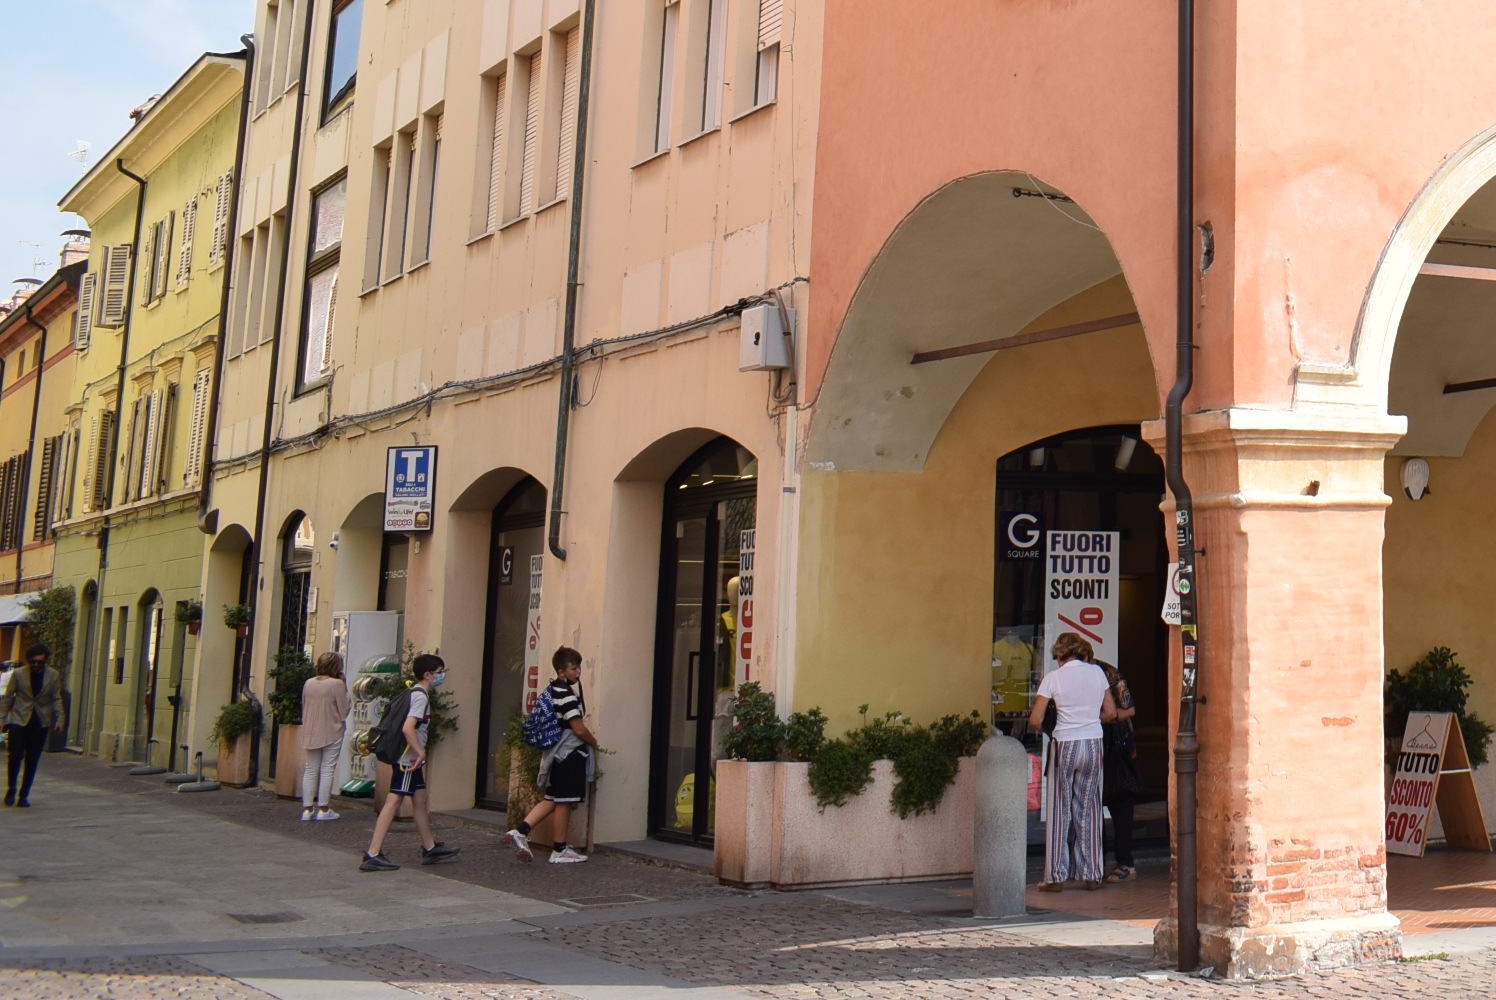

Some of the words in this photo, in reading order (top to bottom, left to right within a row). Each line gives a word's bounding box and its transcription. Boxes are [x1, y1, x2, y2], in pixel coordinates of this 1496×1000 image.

[401, 451, 423, 482] T
[1008, 513, 1040, 548] G
[1050, 533, 1111, 552] FUORI
[502, 548, 511, 575] G
[1007, 550, 1039, 558] SQUARE
[1050, 555, 1111, 574] TUTTO
[1050, 579, 1109, 599] SCONTI
[1398, 752, 1439, 774] TUTTO
[1391, 778, 1433, 808] SCONTO
[1385, 811, 1423, 844] 60%
